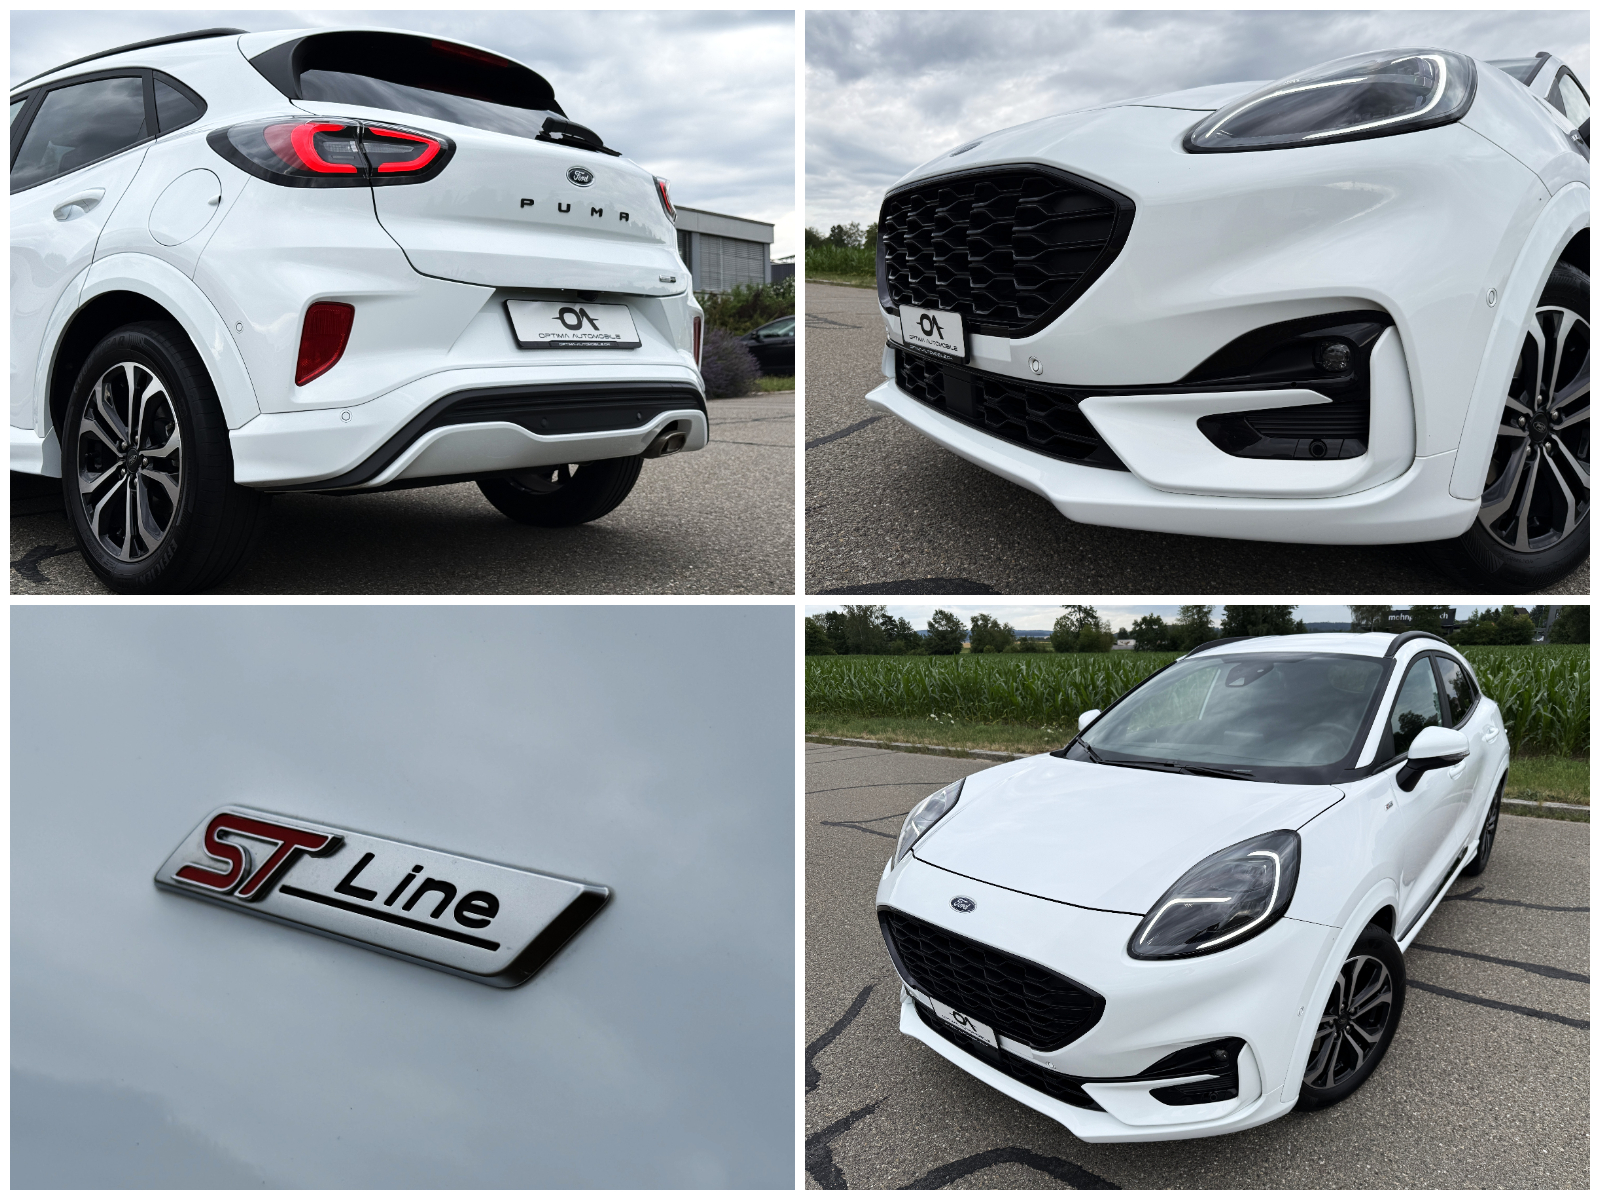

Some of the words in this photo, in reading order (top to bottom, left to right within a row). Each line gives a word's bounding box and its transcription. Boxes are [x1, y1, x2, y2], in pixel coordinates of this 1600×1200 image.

[520, 198, 630, 222] PUMA
[172, 812, 336, 900] ST
[334, 851, 500, 929] Line
